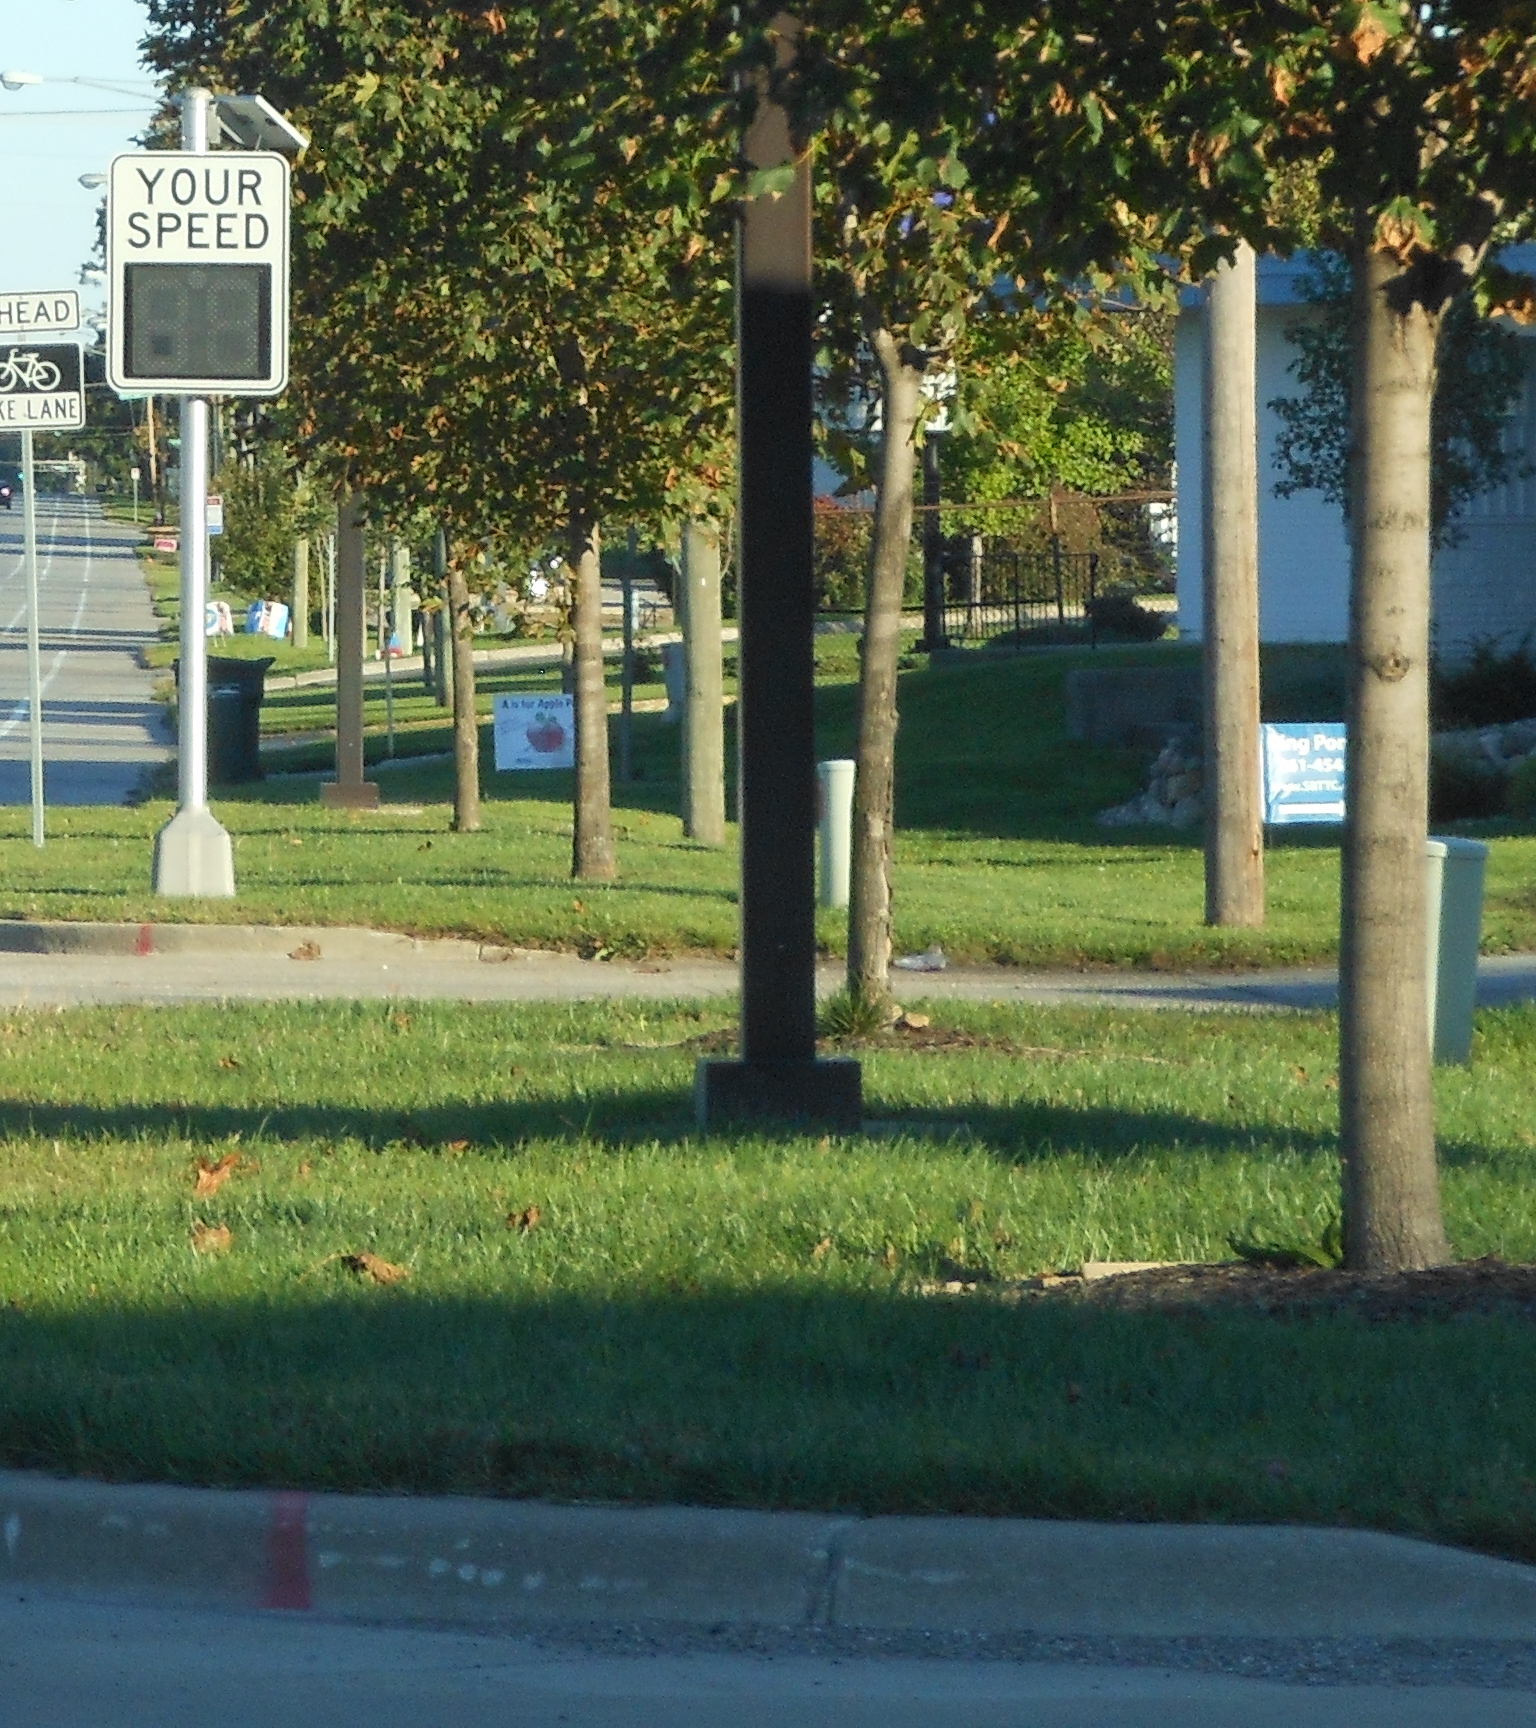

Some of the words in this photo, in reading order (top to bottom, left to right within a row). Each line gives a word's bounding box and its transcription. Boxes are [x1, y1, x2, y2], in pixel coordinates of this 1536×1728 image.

[136, 168, 263, 206] YOUR
[128, 212, 269, 249] SPEED
[26, 397, 78, 421] LANE
